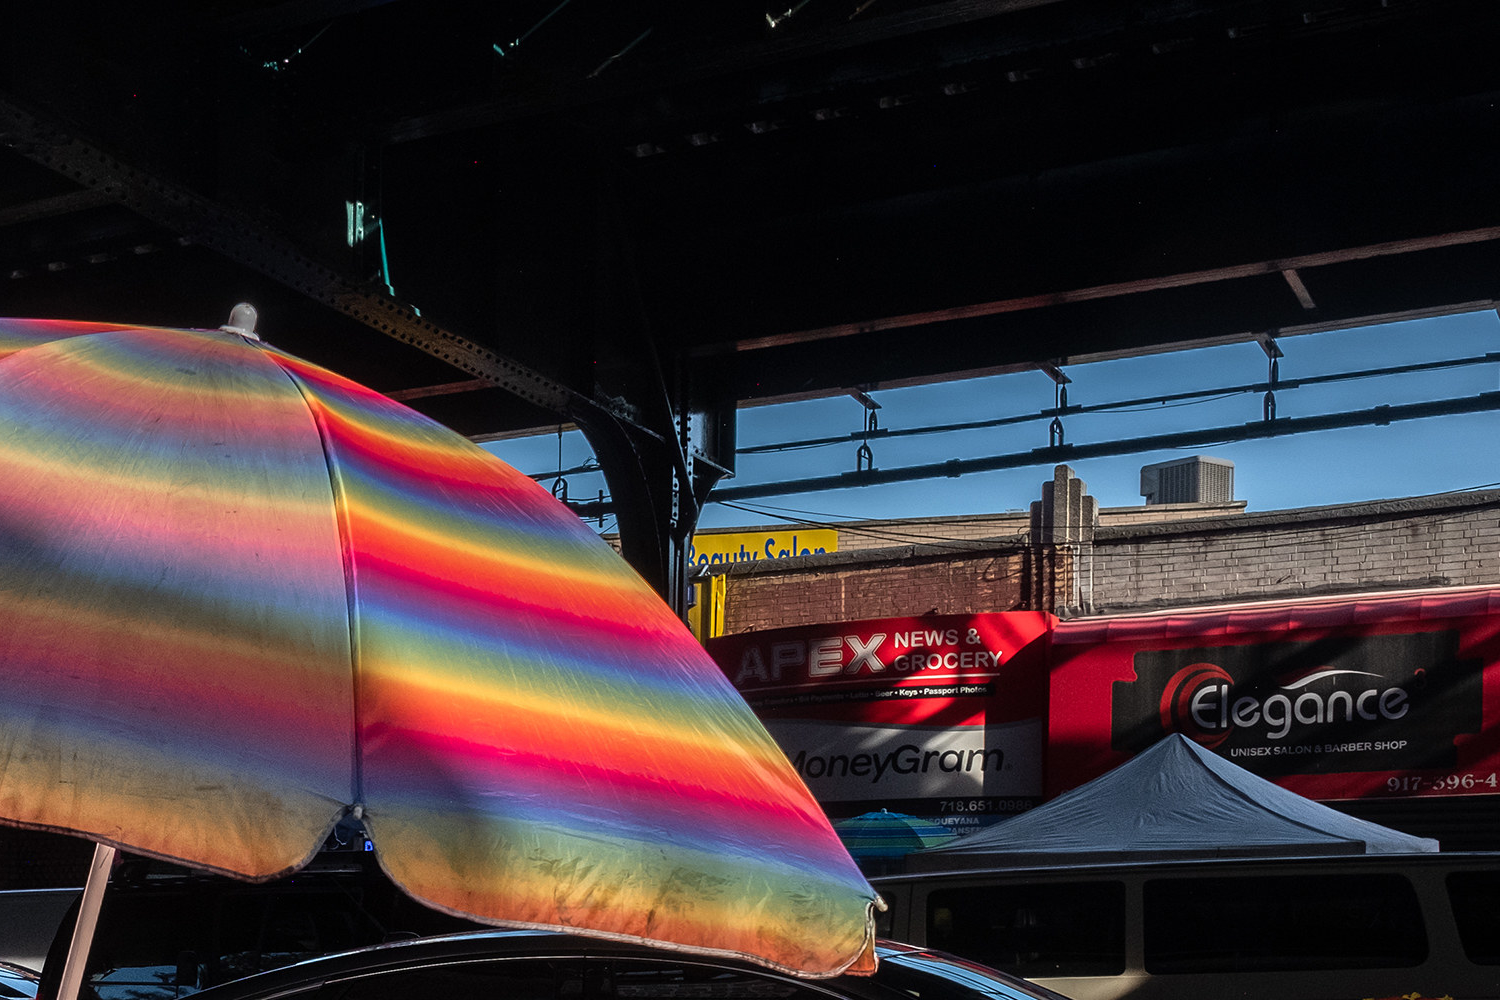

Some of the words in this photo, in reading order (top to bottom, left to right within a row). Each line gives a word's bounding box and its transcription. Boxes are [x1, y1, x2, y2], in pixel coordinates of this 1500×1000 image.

[894, 629, 959, 649] NEWS
[965, 627, 982, 645] &
[736, 632, 887, 686] APEX
[894, 650, 1003, 673] GROCERY
[899, 688, 919, 698] Keys
[923, 687, 959, 697] Passport
[960, 685, 988, 695] Photos
[1191, 684, 1409, 739] Elegance
[1231, 747, 1271, 757] UNISEX
[1274, 745, 1312, 755] SALON
[1324, 742, 1371, 753] BARBER
[1374, 740, 1407, 751] SHOP
